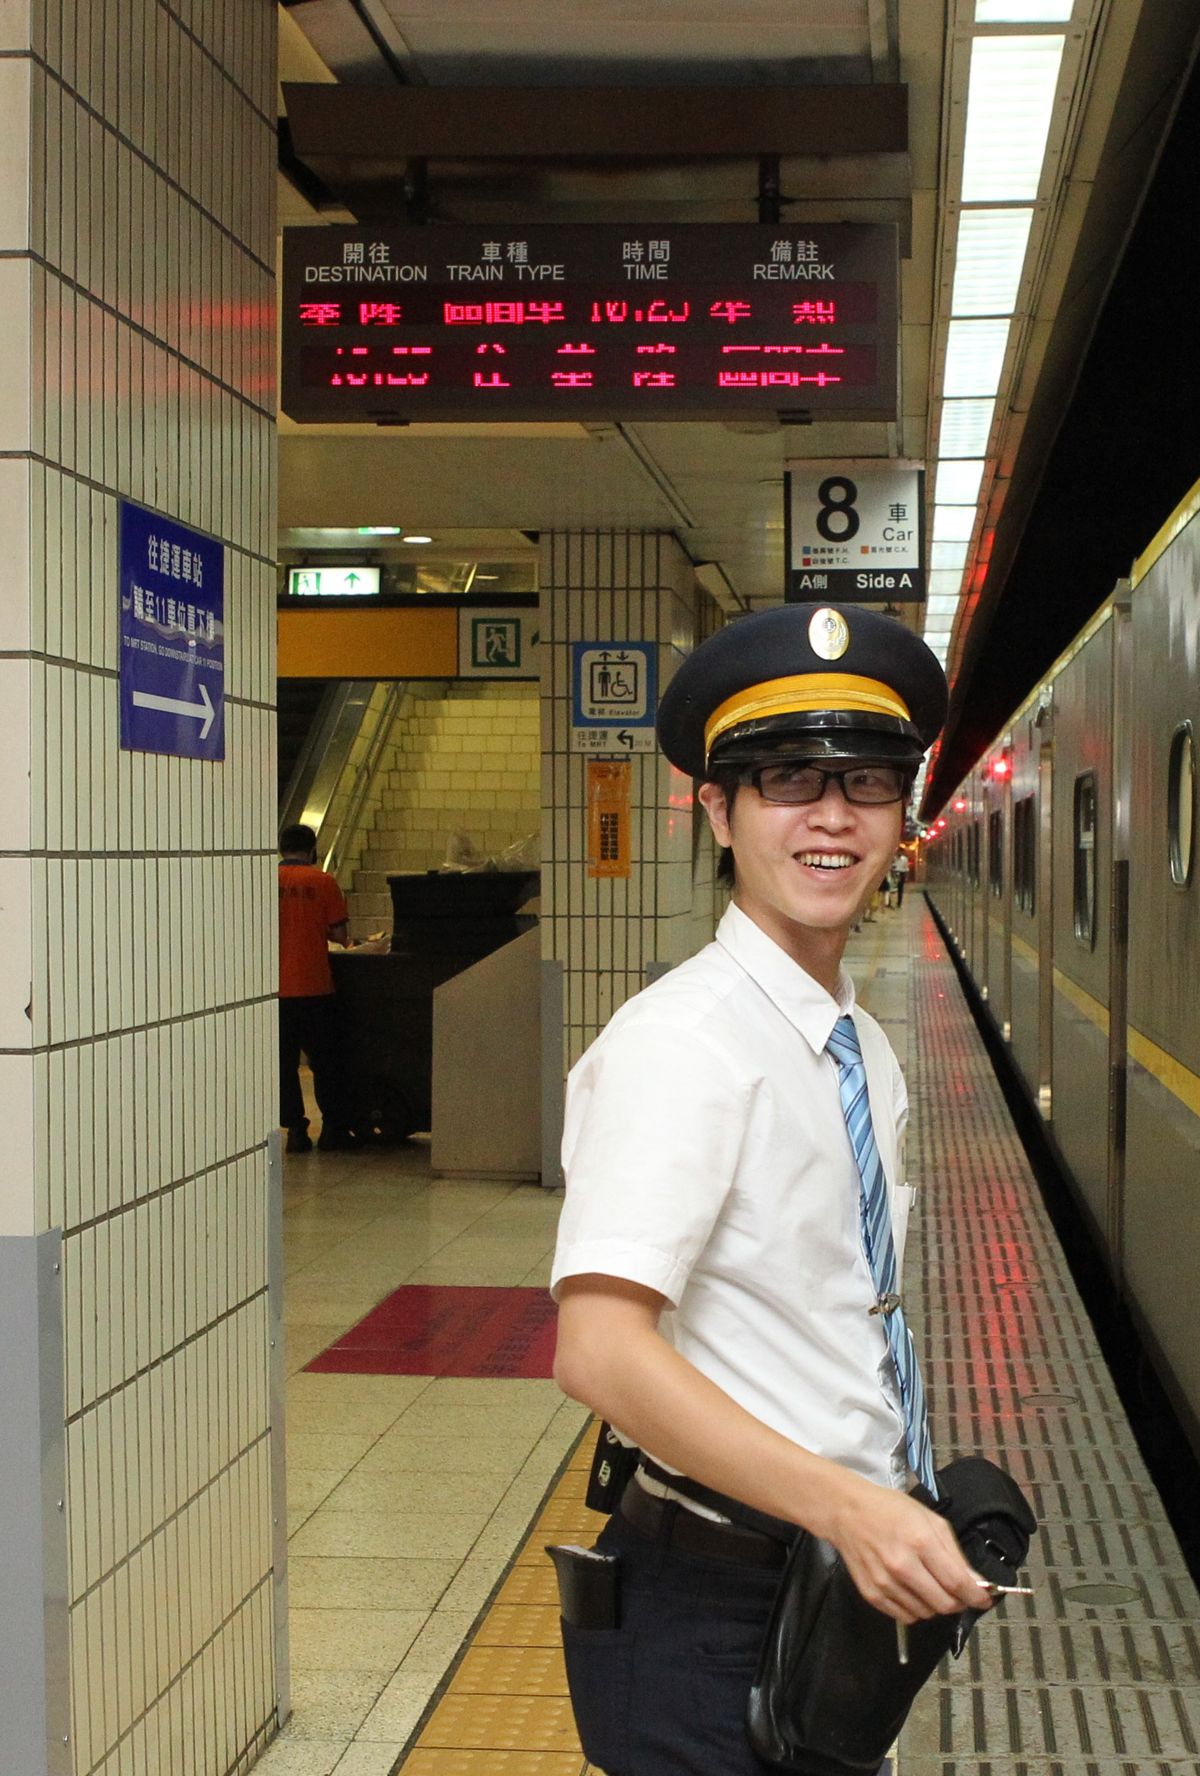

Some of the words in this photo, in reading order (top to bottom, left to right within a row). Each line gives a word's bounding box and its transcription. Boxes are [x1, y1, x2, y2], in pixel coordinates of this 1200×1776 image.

[343, 242, 390, 264] 開往
[481, 241, 528, 263] 車種
[622, 240, 670, 262] 時間
[770, 240, 819, 262] 備註
[305, 265, 427, 282] DESTINATION
[446, 265, 503, 280] TRAIN
[515, 264, 565, 280] TYPE
[624, 264, 668, 280] TIME
[753, 264, 835, 280] REMARK
[816, 475, 860, 543] 8
[888, 502, 908, 524] 車
[882, 527, 914, 542] Car
[147, 534, 203, 589] 往捷運車站
[799, 574, 828, 590] A側
[856, 573, 896, 589] Side
[899, 573, 913, 588] A
